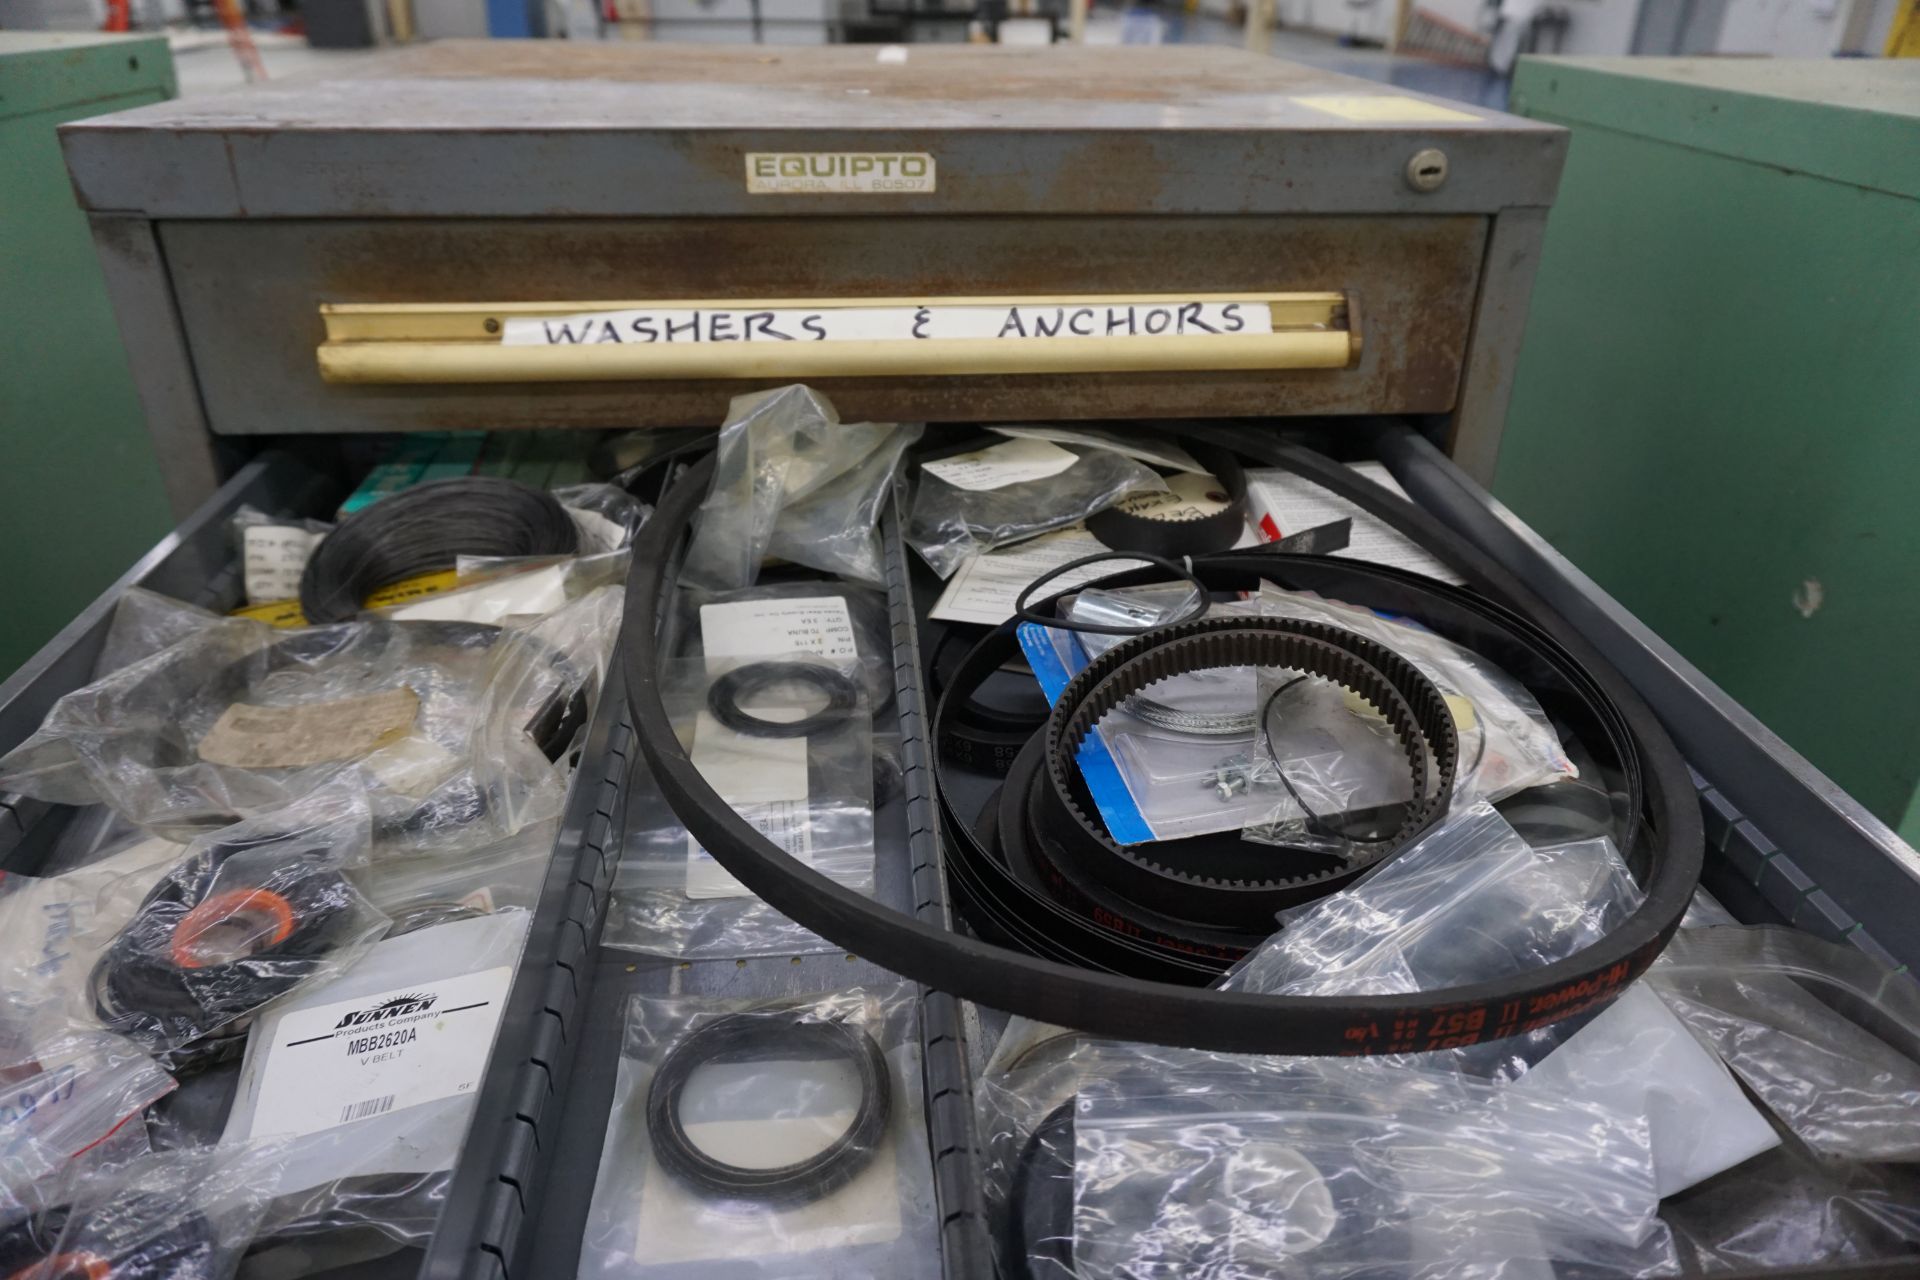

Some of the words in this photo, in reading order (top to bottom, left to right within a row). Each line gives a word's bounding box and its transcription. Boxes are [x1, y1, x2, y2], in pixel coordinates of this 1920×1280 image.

[754, 156, 927, 177] EQUIPTO
[872, 179, 926, 189] 60507
[543, 311, 827, 344] WASHERS
[998, 302, 1245, 338] ANCHORS
[335, 996, 438, 1030] SUNNEN
[335, 1021, 385, 1038] Products
[388, 1010, 441, 1027] Company
[1428, 1007, 1486, 1035] B57
[347, 1027, 417, 1056] MBB2620A
[360, 1057, 370, 1066] V
[372, 1049, 405, 1064] BELT
